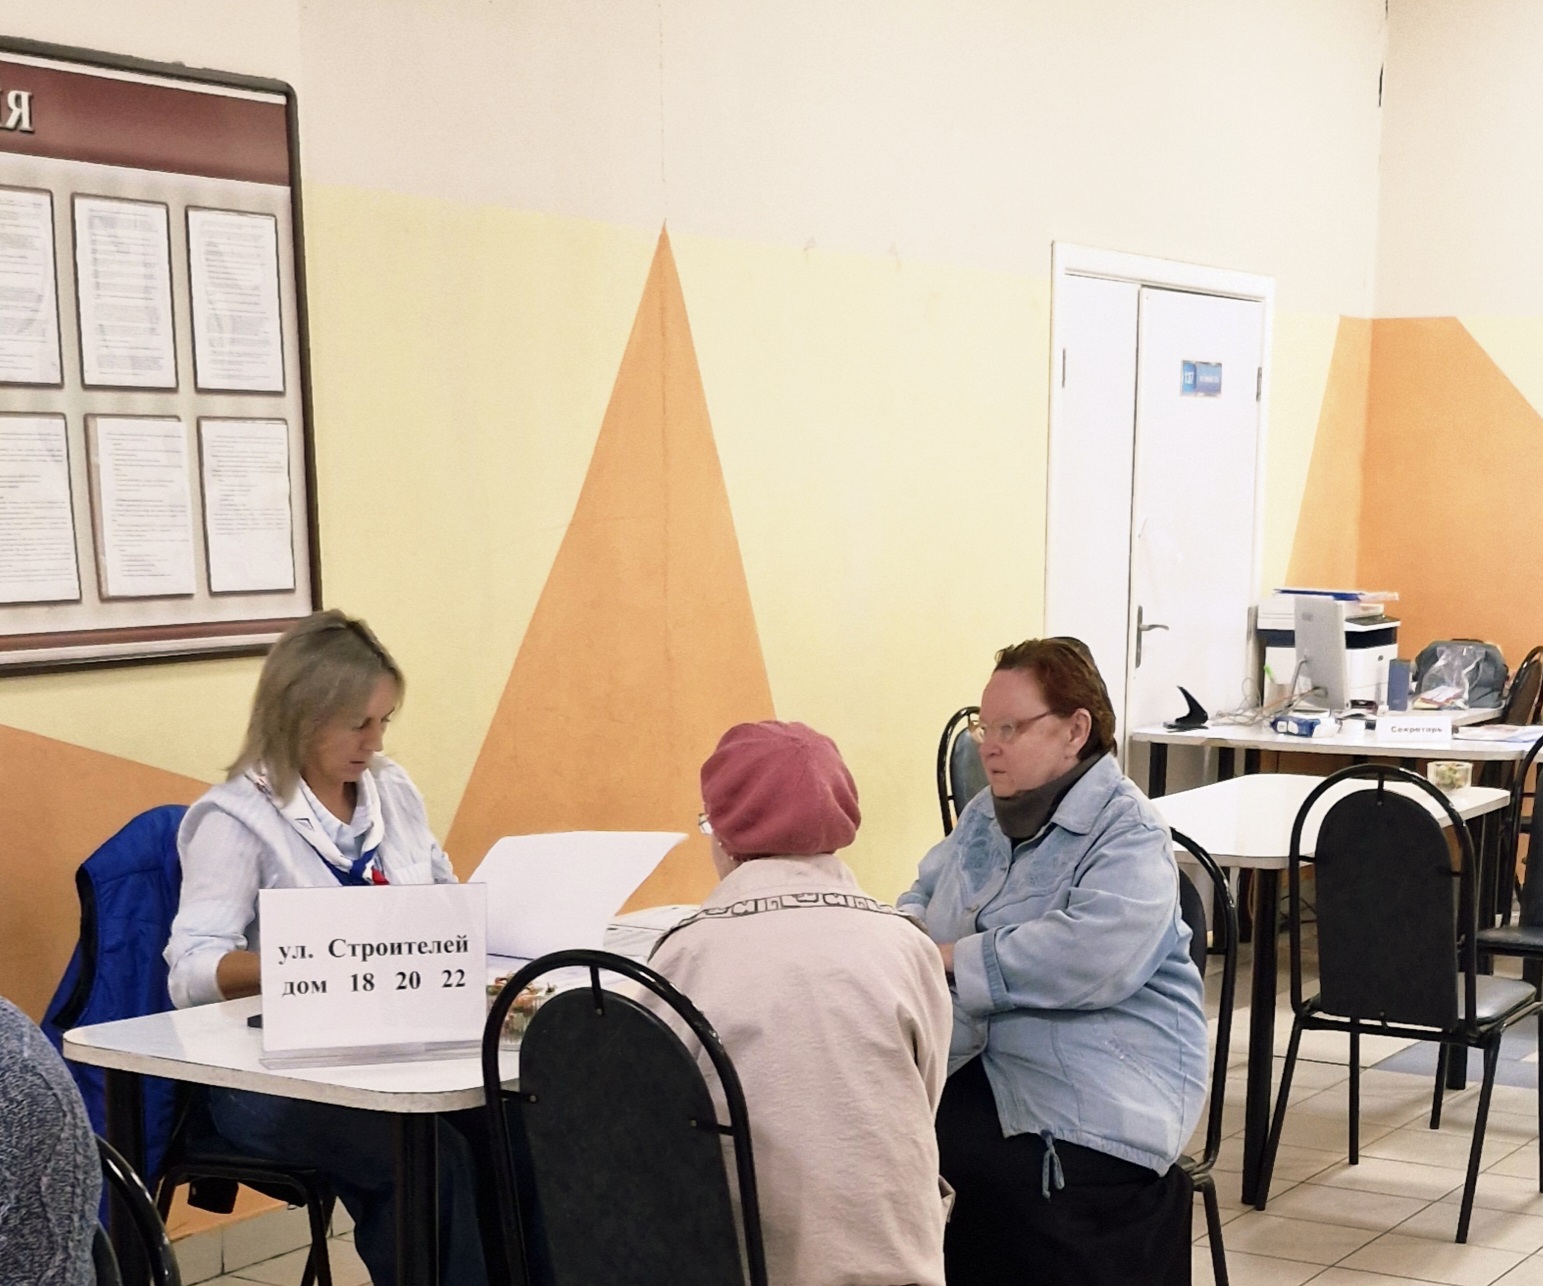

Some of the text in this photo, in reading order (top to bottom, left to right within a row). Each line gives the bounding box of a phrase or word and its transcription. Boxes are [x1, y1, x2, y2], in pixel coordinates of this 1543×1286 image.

[0, 89, 33, 131] Я
[1391, 726, 1443, 734] Секретарь
[278, 934, 469, 965] ул. Строителей
[282, 968, 466, 998] дом 18 20 22
